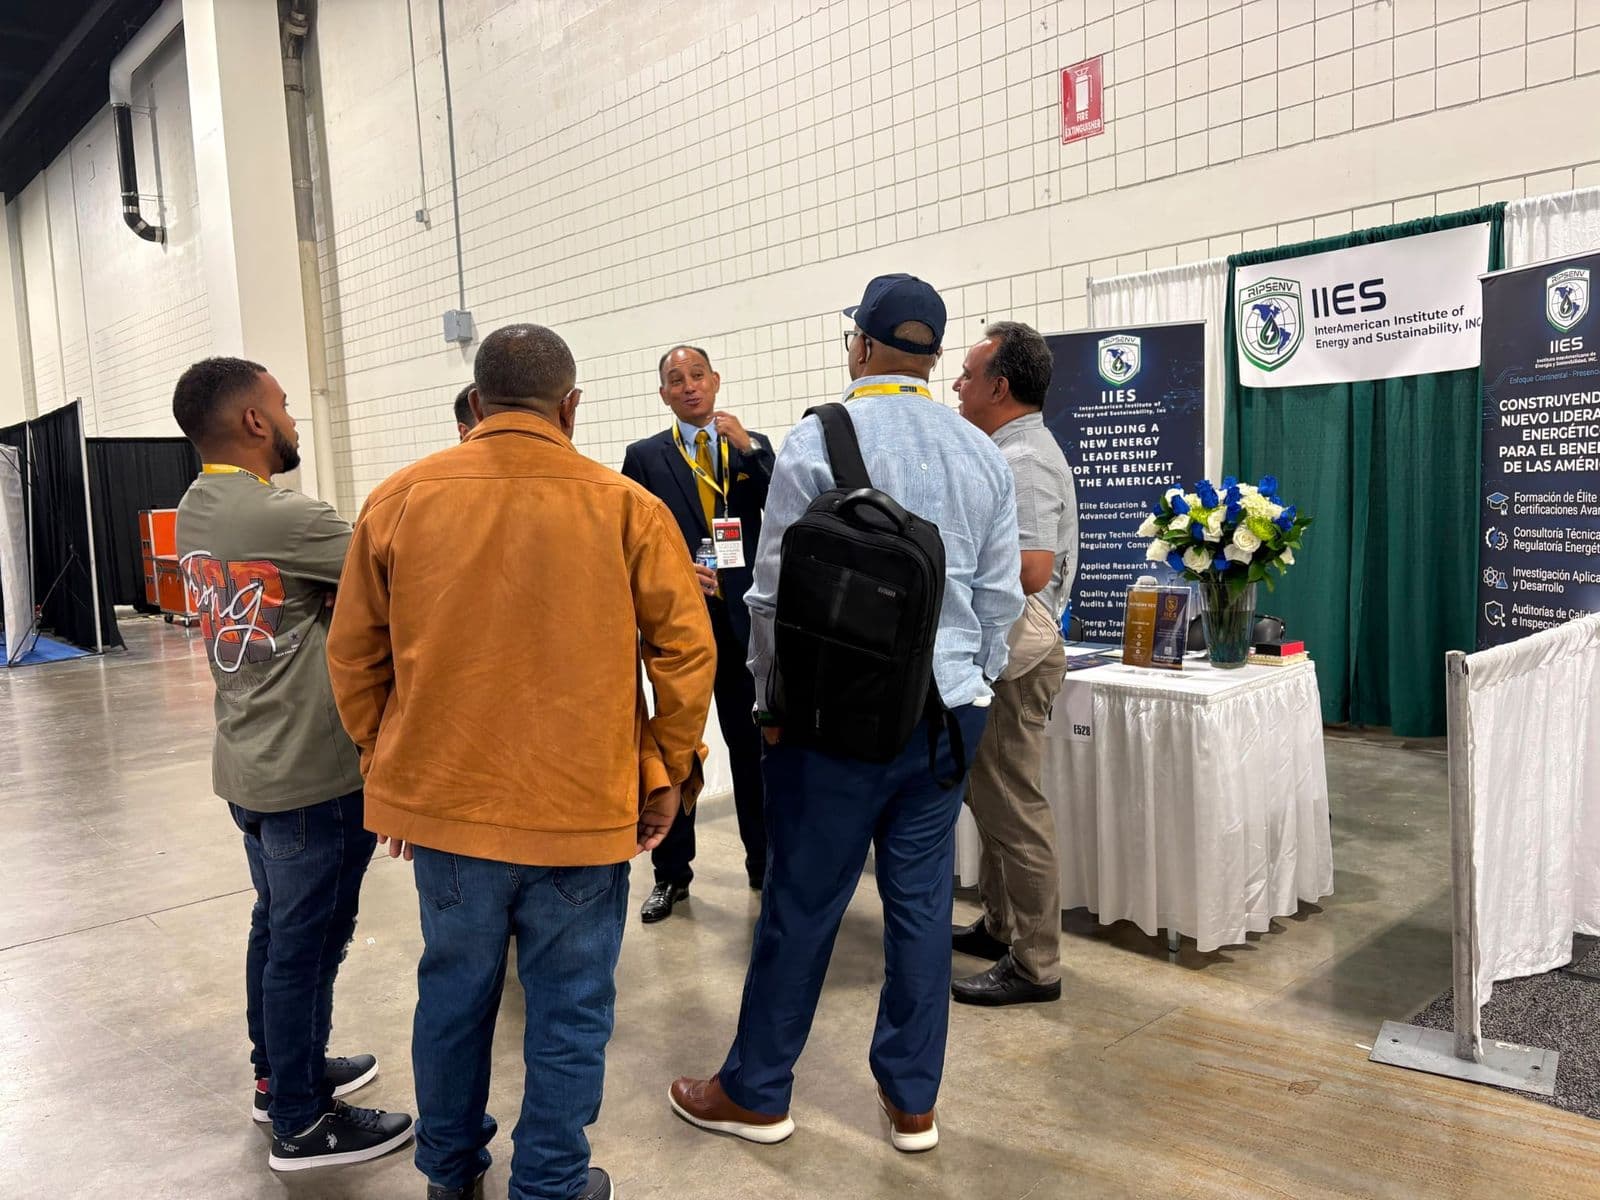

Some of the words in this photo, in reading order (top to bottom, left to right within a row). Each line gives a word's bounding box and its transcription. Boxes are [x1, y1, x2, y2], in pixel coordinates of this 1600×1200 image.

[1552, 270, 1585, 283] RIPSENV
[1248, 282, 1293, 298] RIPSENV
[1312, 278, 1387, 318] IIES
[1314, 318, 1390, 336] InterAmerican
[1394, 310, 1448, 325] Institute
[1452, 305, 1464, 316] of
[1316, 336, 1349, 350] Energy
[1352, 334, 1372, 345] and
[1376, 322, 1462, 342] Sustainability,
[1550, 336, 1583, 354] IIES
[1510, 376, 1534, 384] Enfoque
[1535, 372, 1568, 382] Continental
[1102, 389, 1136, 404] IIES
[1502, 412, 1549, 427] NUEVO
[1080, 424, 1146, 435] "BUILDING
[1151, 423, 1159, 432] A
[1522, 424, 1600, 440] ENERGÉTIC
[1080, 439, 1107, 449] NEW
[1112, 437, 1160, 447] ENERGY
[1082, 450, 1157, 461] LEADERSHIP
[1499, 445, 1536, 458] PARA
[1540, 444, 1556, 456] EL
[1095, 464, 1118, 474] THE
[1123, 462, 1173, 473] BENEFIT
[1504, 461, 1522, 473] DE
[1526, 460, 1551, 472] LAS
[1554, 456, 1600, 472] AMÉRI
[1079, 478, 1102, 488] THE
[1107, 475, 1181, 487] AMERICAS!"
[1514, 491, 1561, 502] Formación
[1563, 492, 1574, 503] de
[1577, 489, 1597, 503] Élite
[1080, 512, 1117, 520] Advanced
[1514, 504, 1578, 515] Certificaciones
[1080, 532, 1106, 540] Energy
[1080, 542, 1122, 550] Regulatory
[1080, 573, 1132, 581] Development
[1513, 567, 1570, 580] Investigación
[1513, 581, 1518, 591] y
[1520, 580, 1564, 593] Desarrollo
[1080, 590, 1108, 598] Quality
[1512, 603, 1554, 617] Auditorías
[1556, 608, 1566, 618] de
[1512, 617, 1517, 626] e
[1074, 724, 1090, 736] E528
